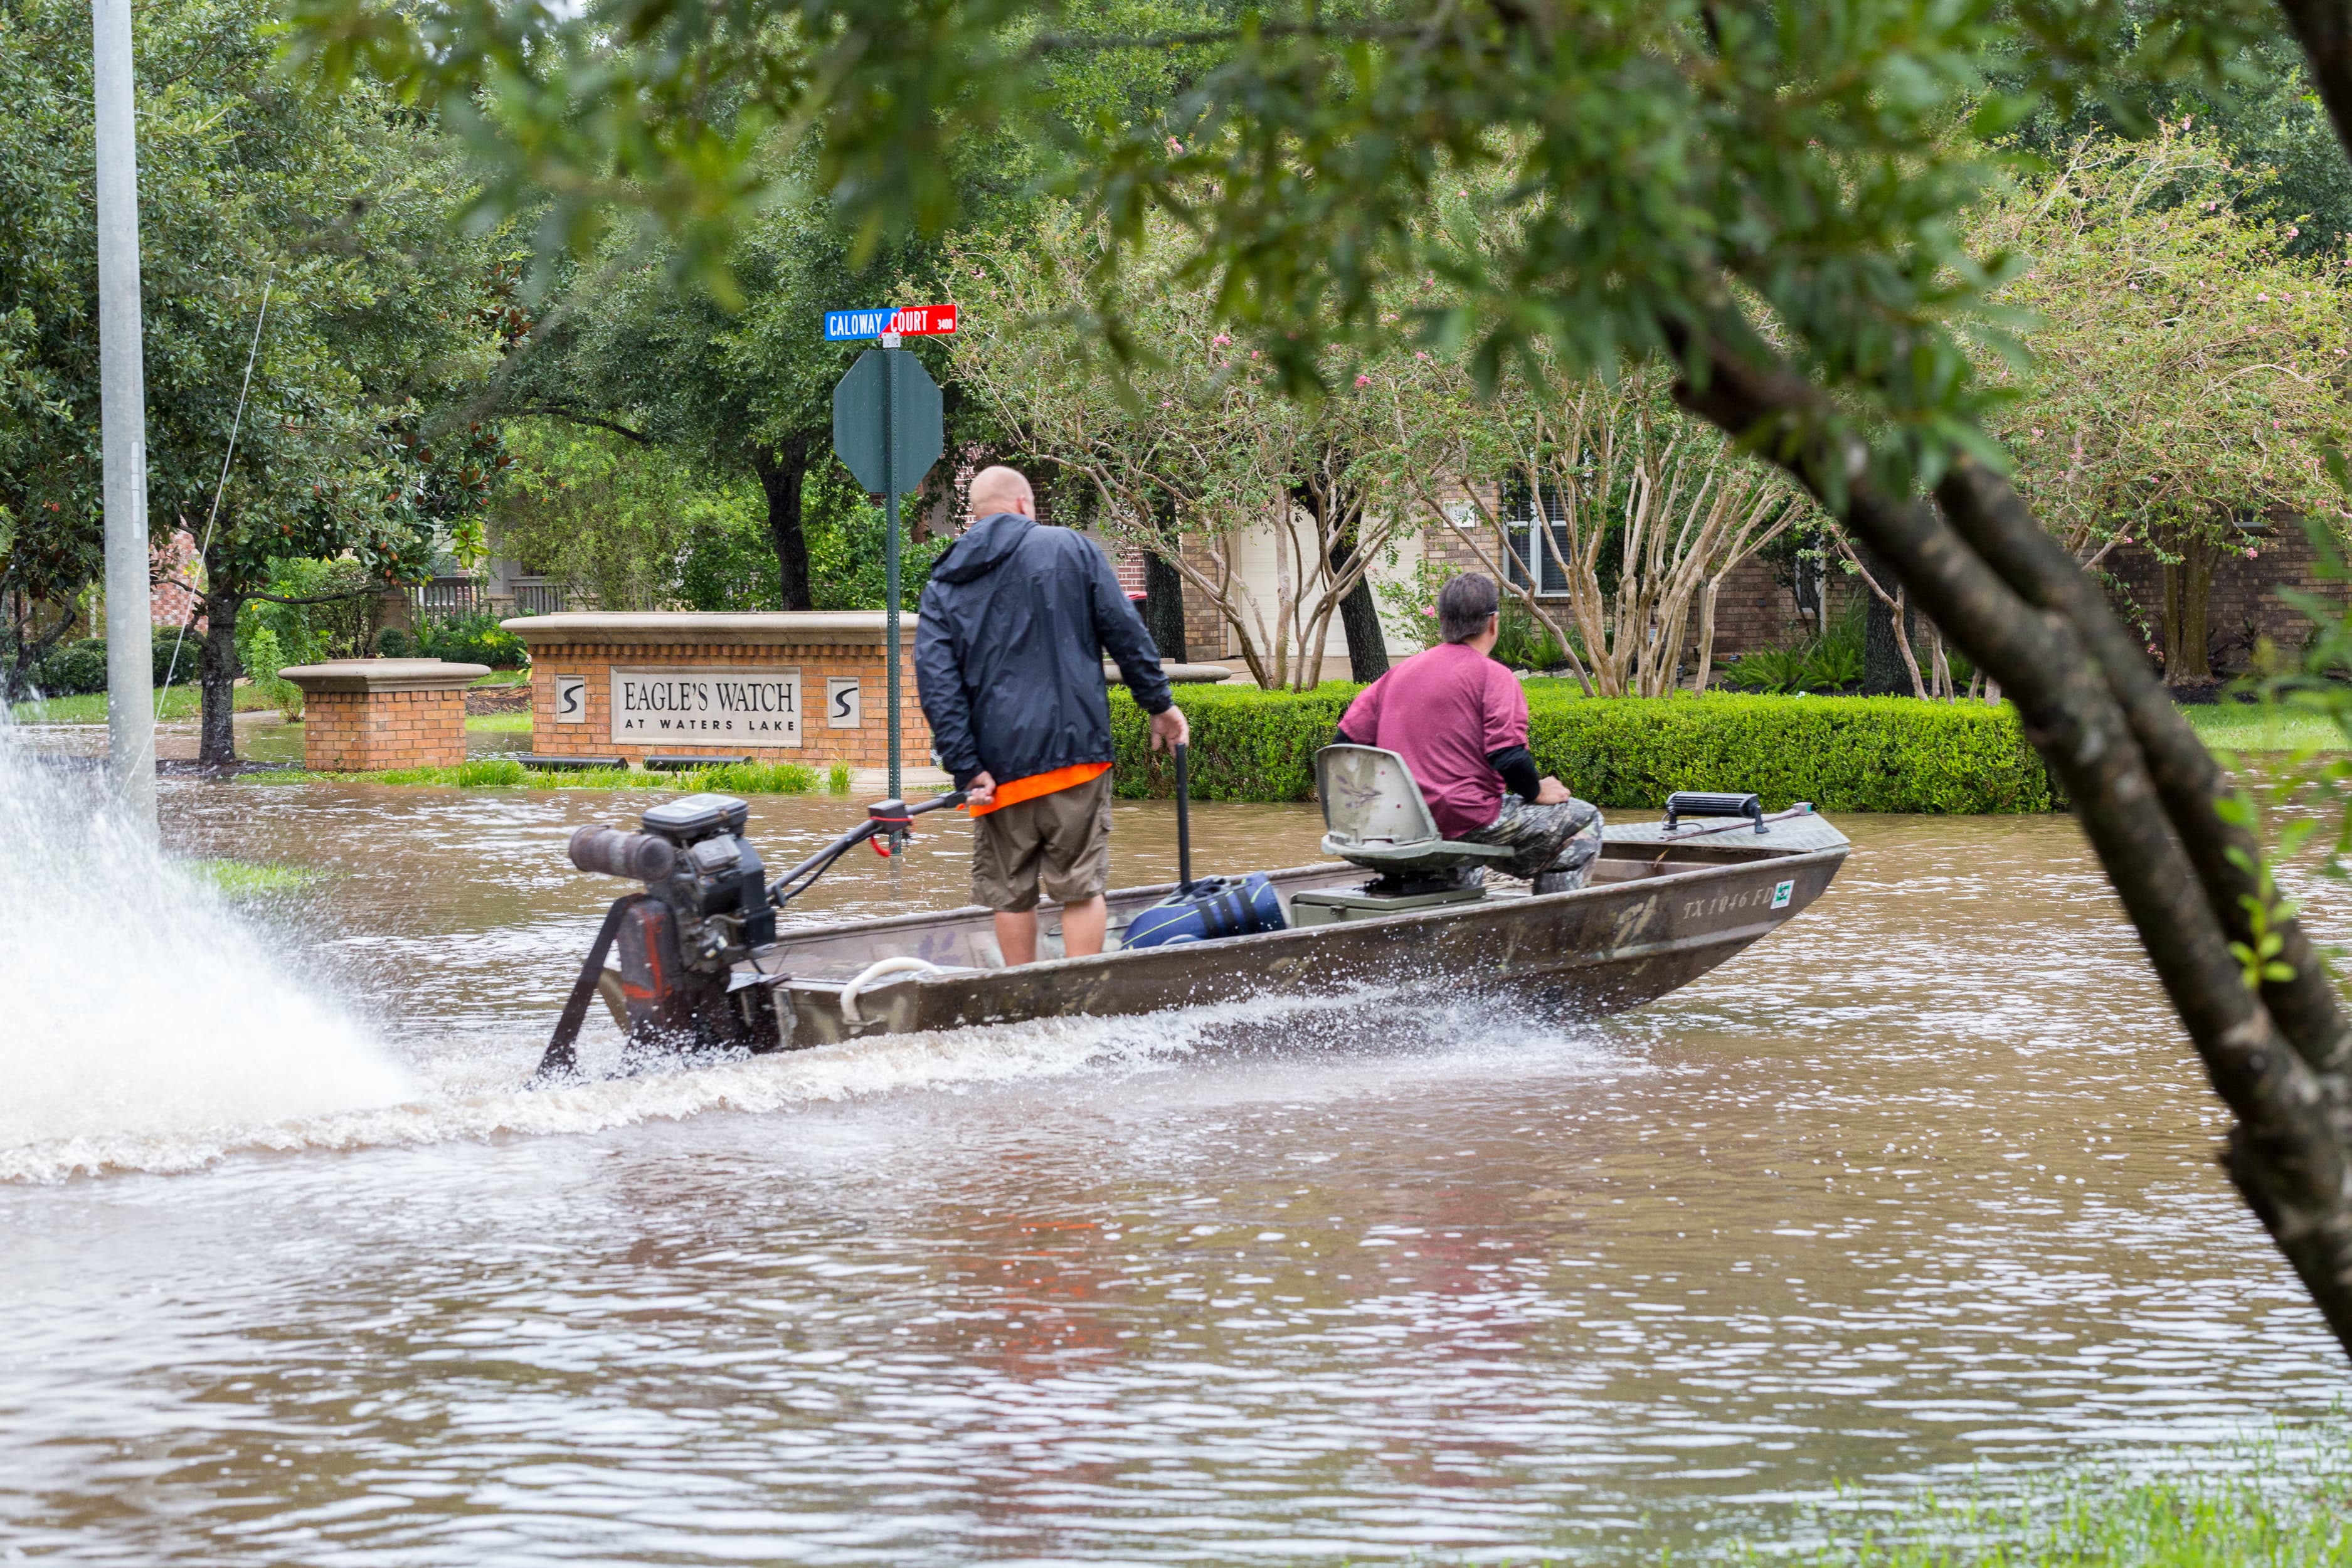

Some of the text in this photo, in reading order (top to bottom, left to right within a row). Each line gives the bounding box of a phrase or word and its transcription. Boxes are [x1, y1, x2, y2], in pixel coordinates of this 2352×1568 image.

[830, 310, 953, 336] CALOWAY COURT 3400
[624, 682, 794, 712] EAGLE'S WATCH
[625, 719, 794, 731] AT WATERS LAKE
[1683, 899, 1705, 919] TX
[1751, 887, 1774, 904] FD
